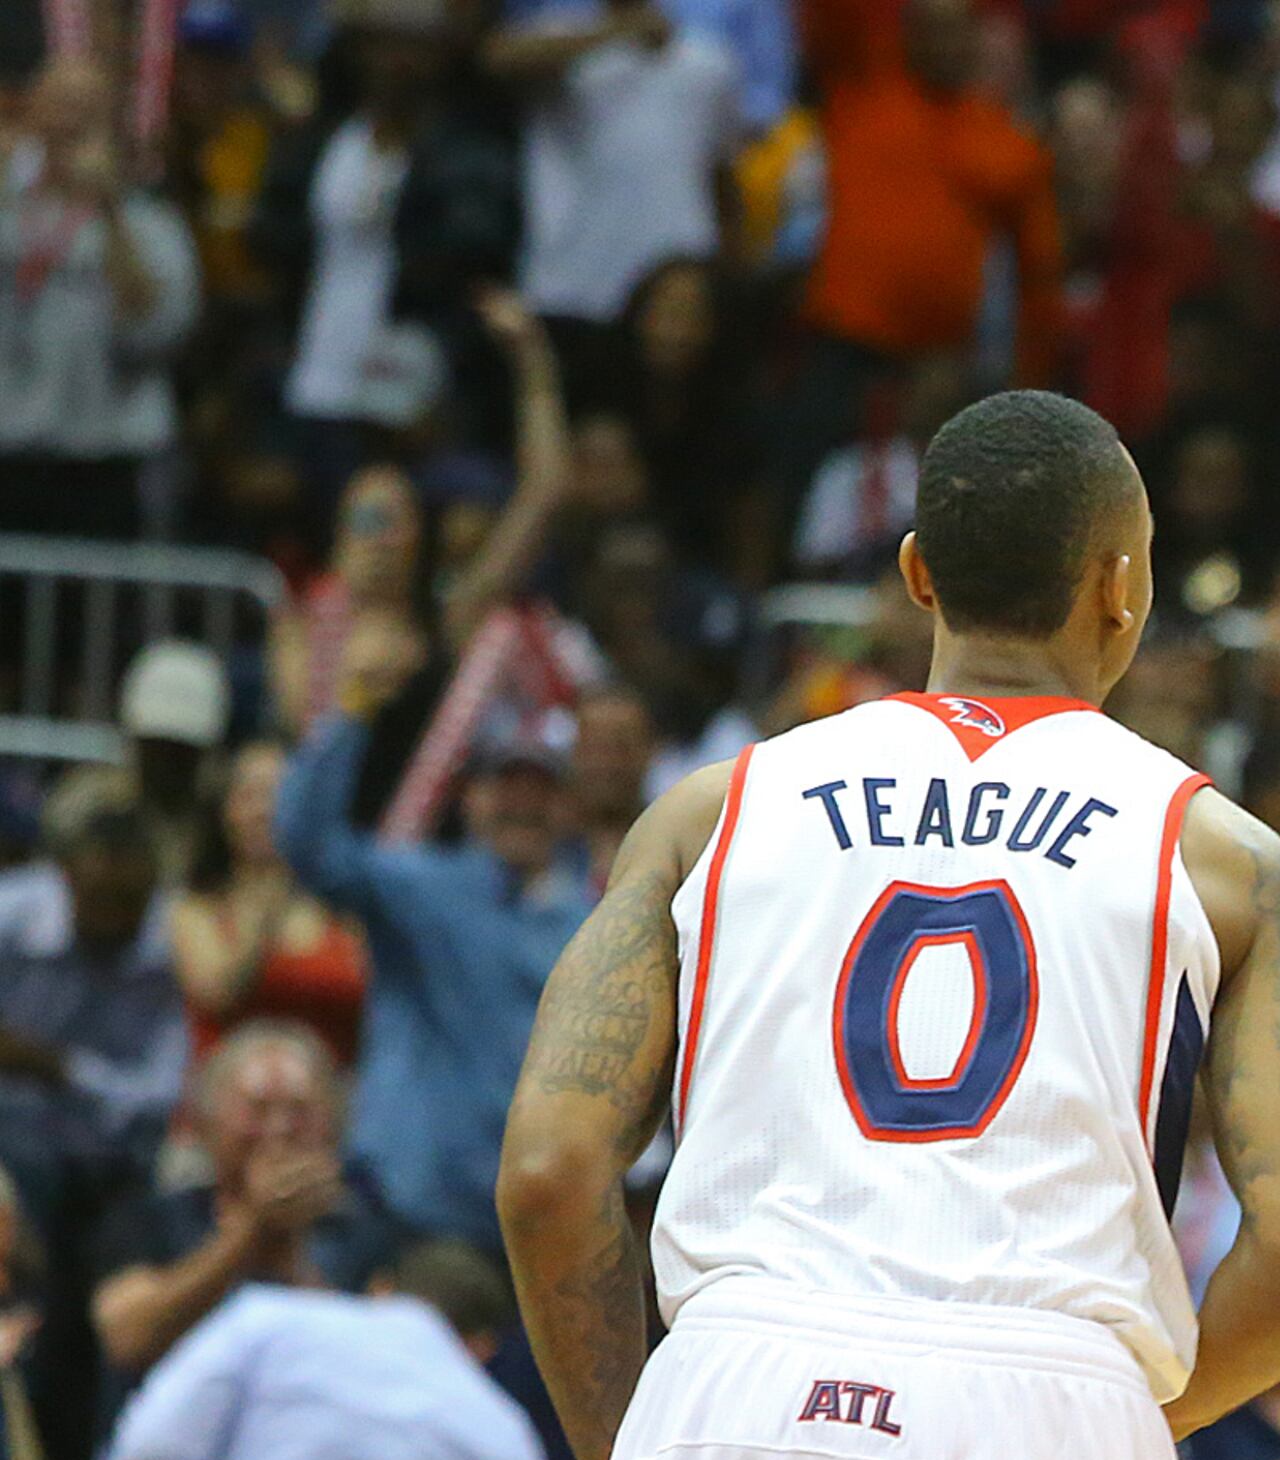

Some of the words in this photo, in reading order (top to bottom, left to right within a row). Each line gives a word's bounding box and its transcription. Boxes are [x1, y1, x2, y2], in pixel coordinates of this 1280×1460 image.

[801, 777, 1119, 869] TEAGUE
[832, 878, 1040, 1143] 0
[797, 1379, 902, 1437] ATL
